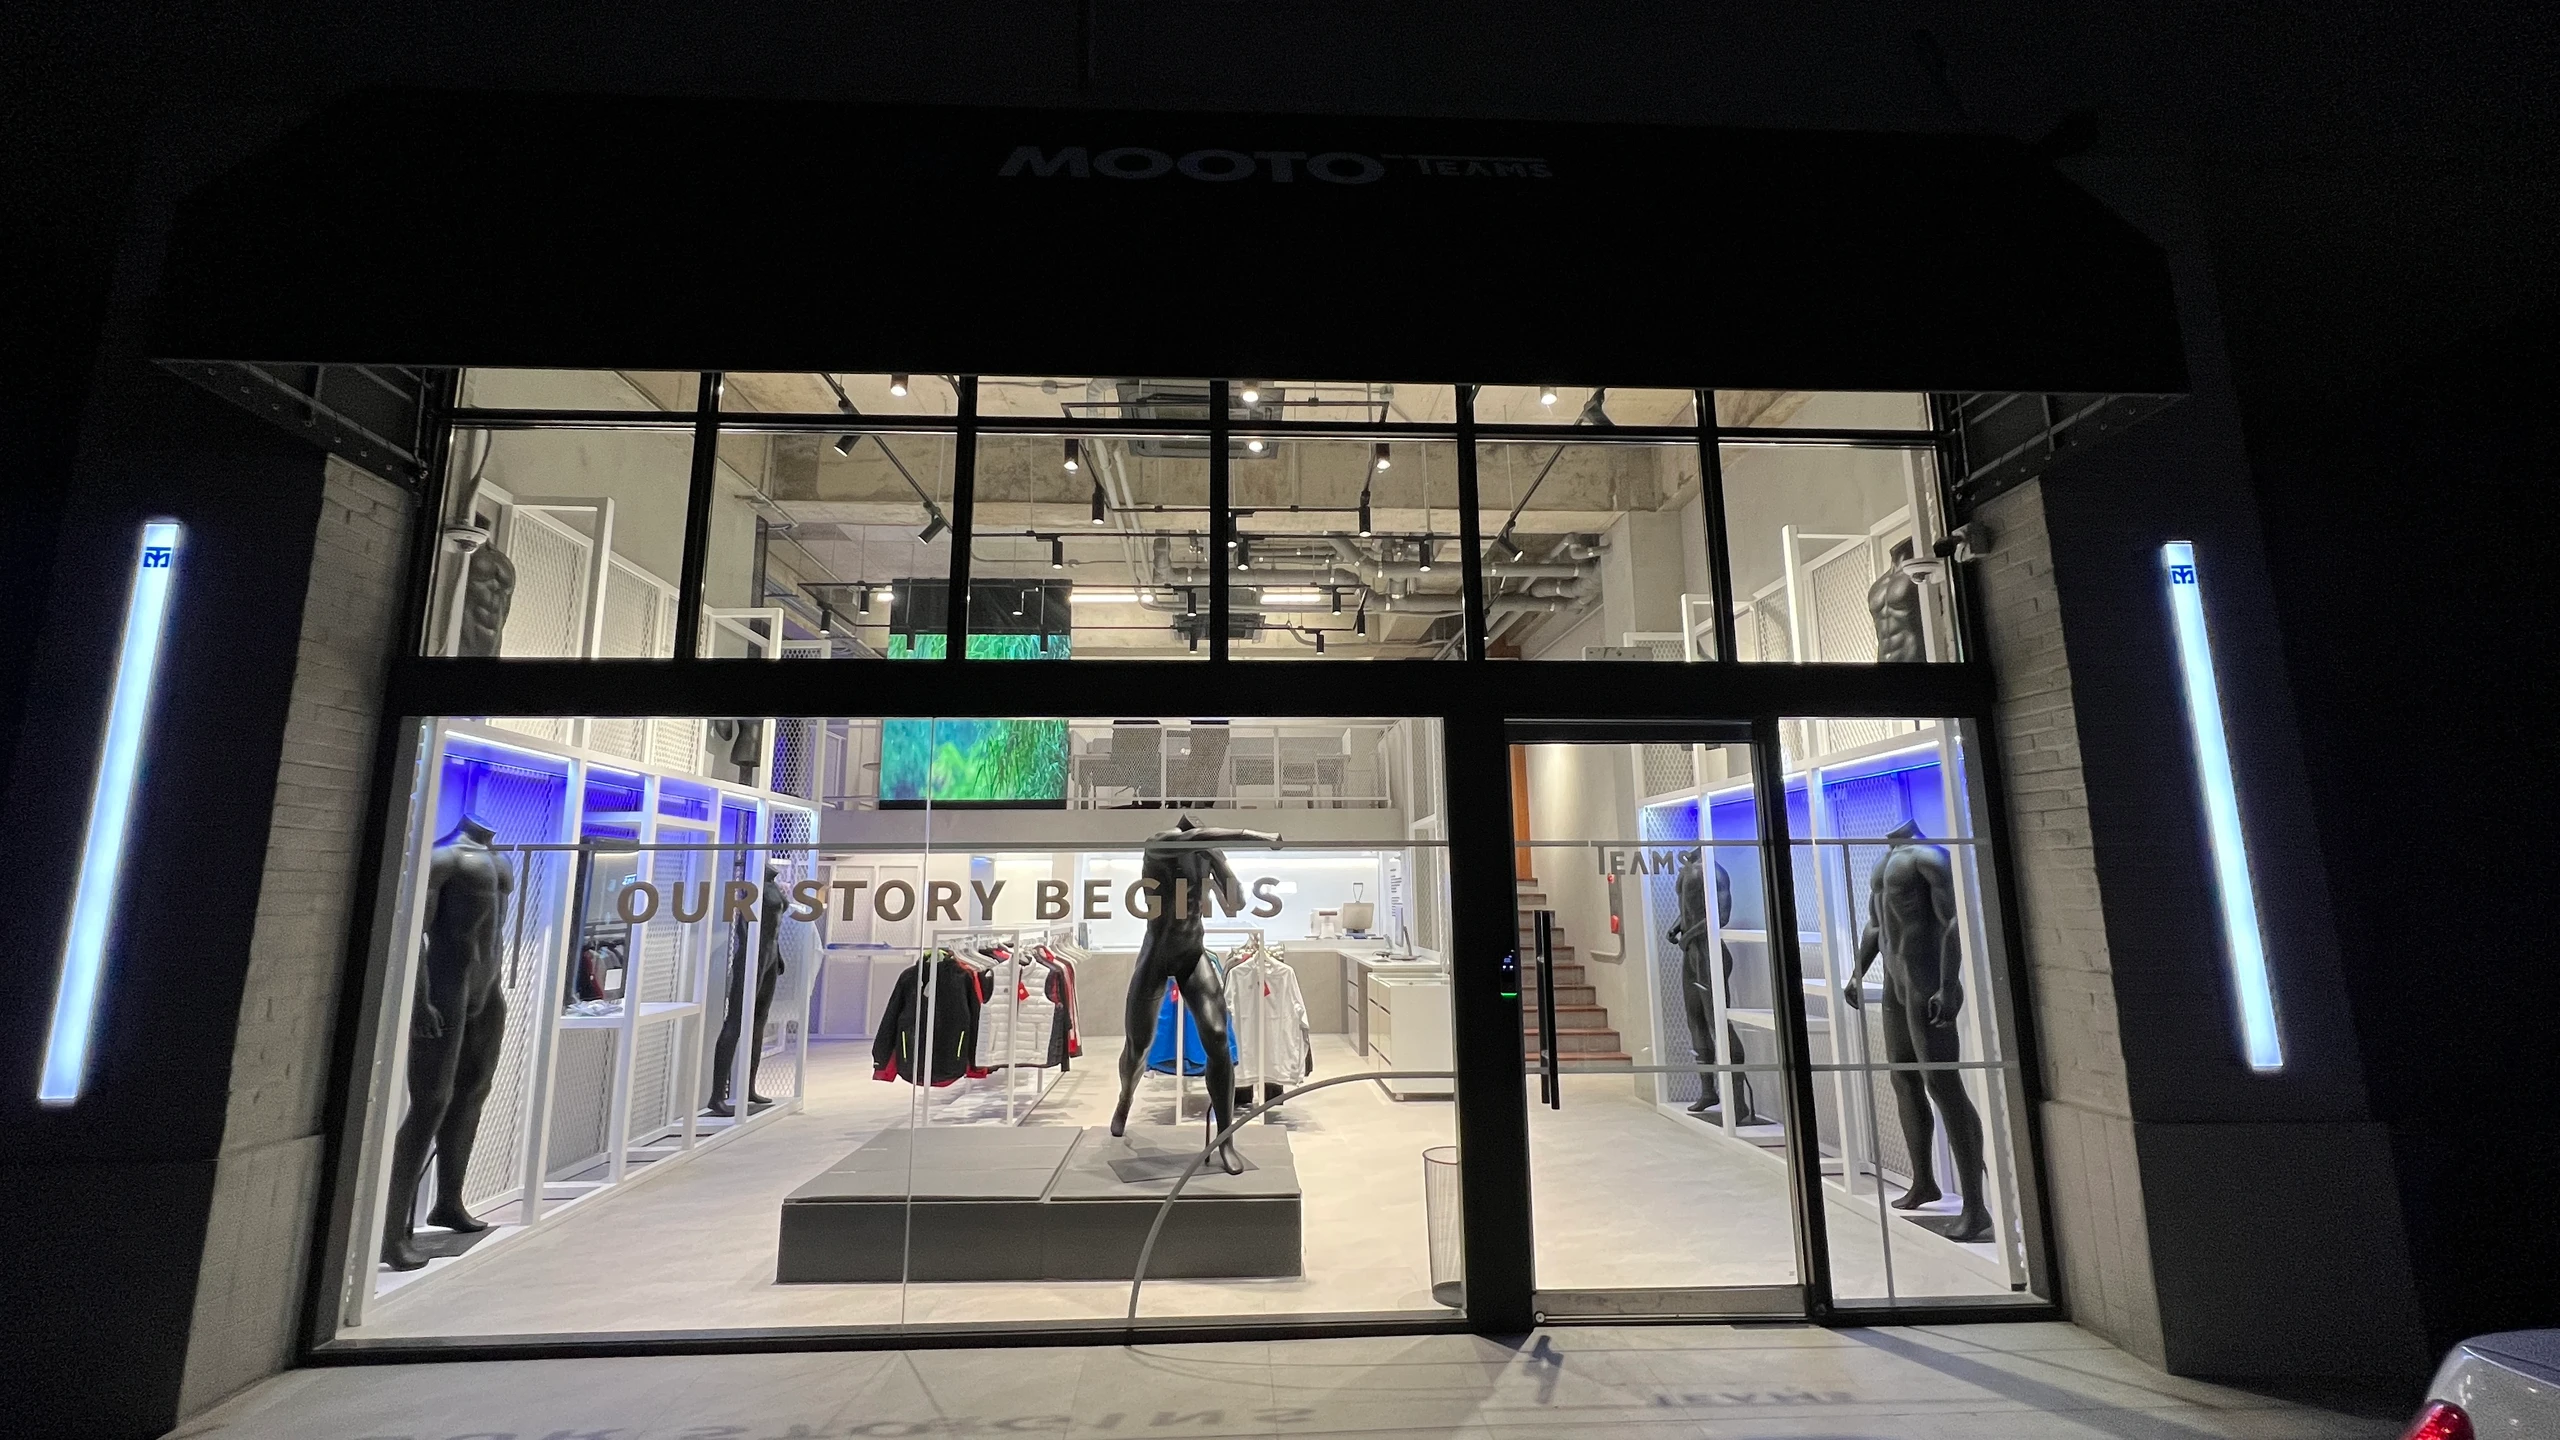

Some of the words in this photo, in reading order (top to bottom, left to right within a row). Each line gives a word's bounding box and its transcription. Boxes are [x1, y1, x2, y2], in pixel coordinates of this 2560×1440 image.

[998, 145, 1386, 184] MOOTO
[1415, 153, 1553, 179] TEAMS
[1598, 842, 1694, 876] TEAMS
[617, 880, 760, 924] OUR
[789, 879, 1007, 923] STORY
[1036, 876, 1284, 920] BEGINS
